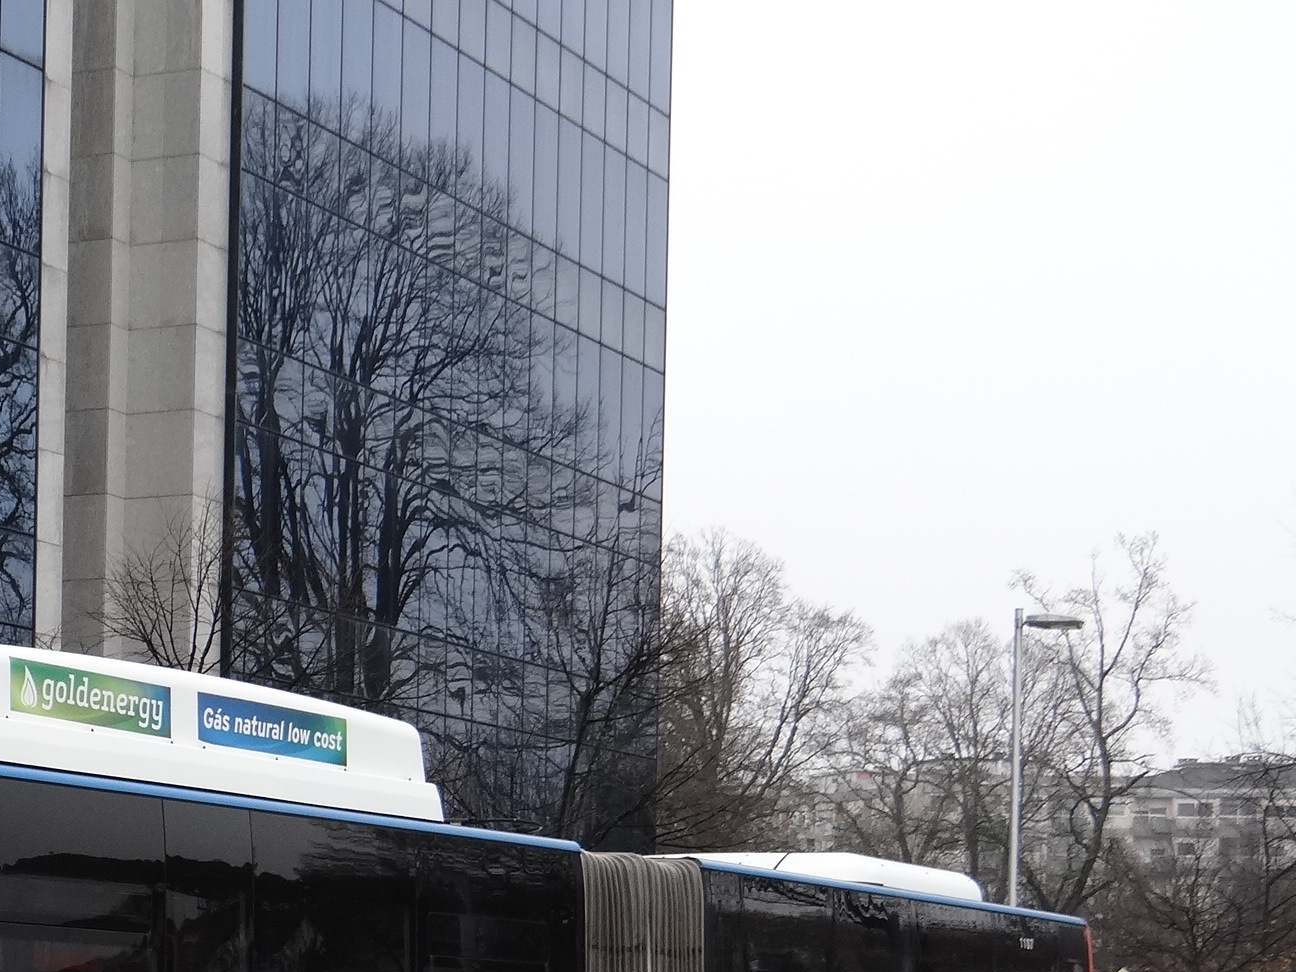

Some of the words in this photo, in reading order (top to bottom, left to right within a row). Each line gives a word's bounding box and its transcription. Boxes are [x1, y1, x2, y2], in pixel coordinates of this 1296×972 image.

[42, 674, 163, 730] goldenergy
[203, 707, 230, 732] Gás
[234, 715, 285, 741] natural
[287, 722, 311, 746] low
[313, 730, 343, 752] cost
